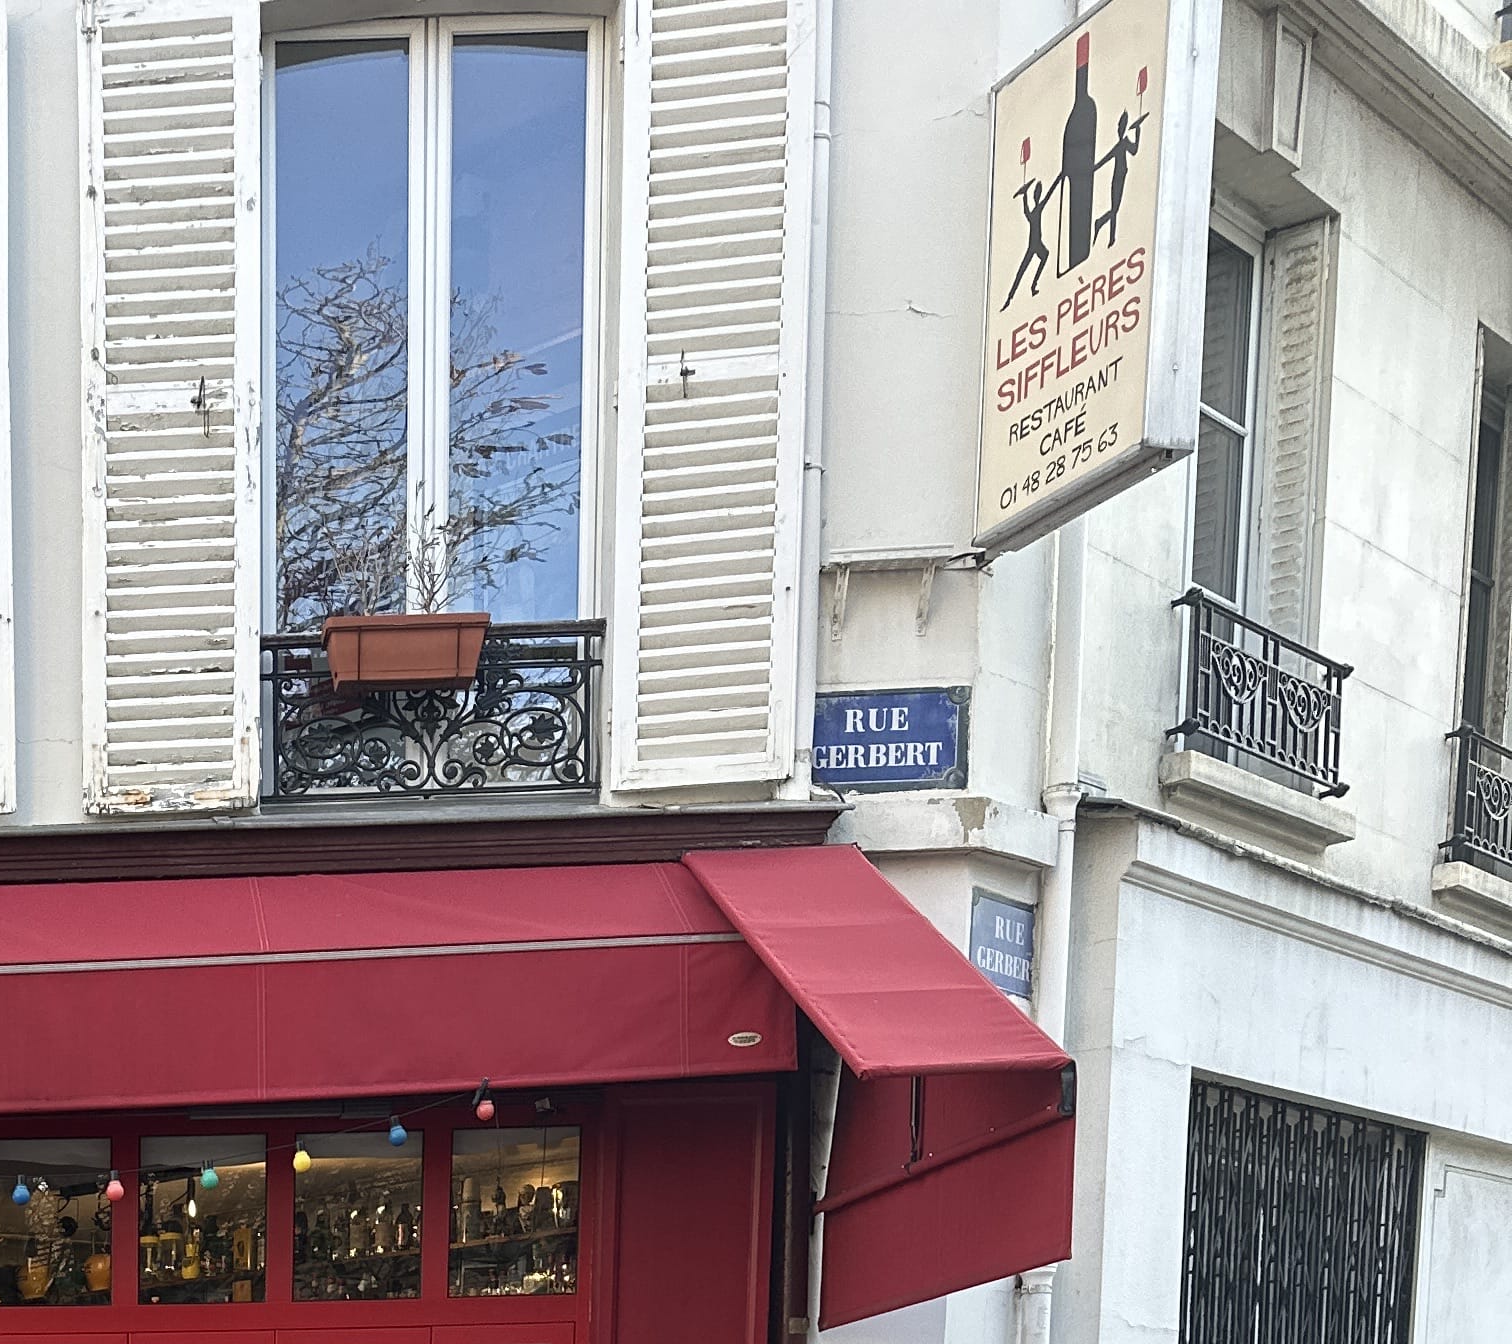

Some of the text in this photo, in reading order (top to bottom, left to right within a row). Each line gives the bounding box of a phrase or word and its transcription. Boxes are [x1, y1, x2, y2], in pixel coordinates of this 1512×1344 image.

[996, 247, 1146, 371] LES PÈRES
[996, 296, 1141, 412] SIFFLEURS
[1008, 356, 1123, 446] RESTAURANT
[1039, 403, 1087, 456] CAFÉ
[999, 422, 1119, 510] 01 48 28 75 63
[844, 707, 909, 734] RUE
[812, 742, 943, 769] GERBERT
[995, 915, 1025, 946] RUE
[977, 945, 1033, 982] GERBER
